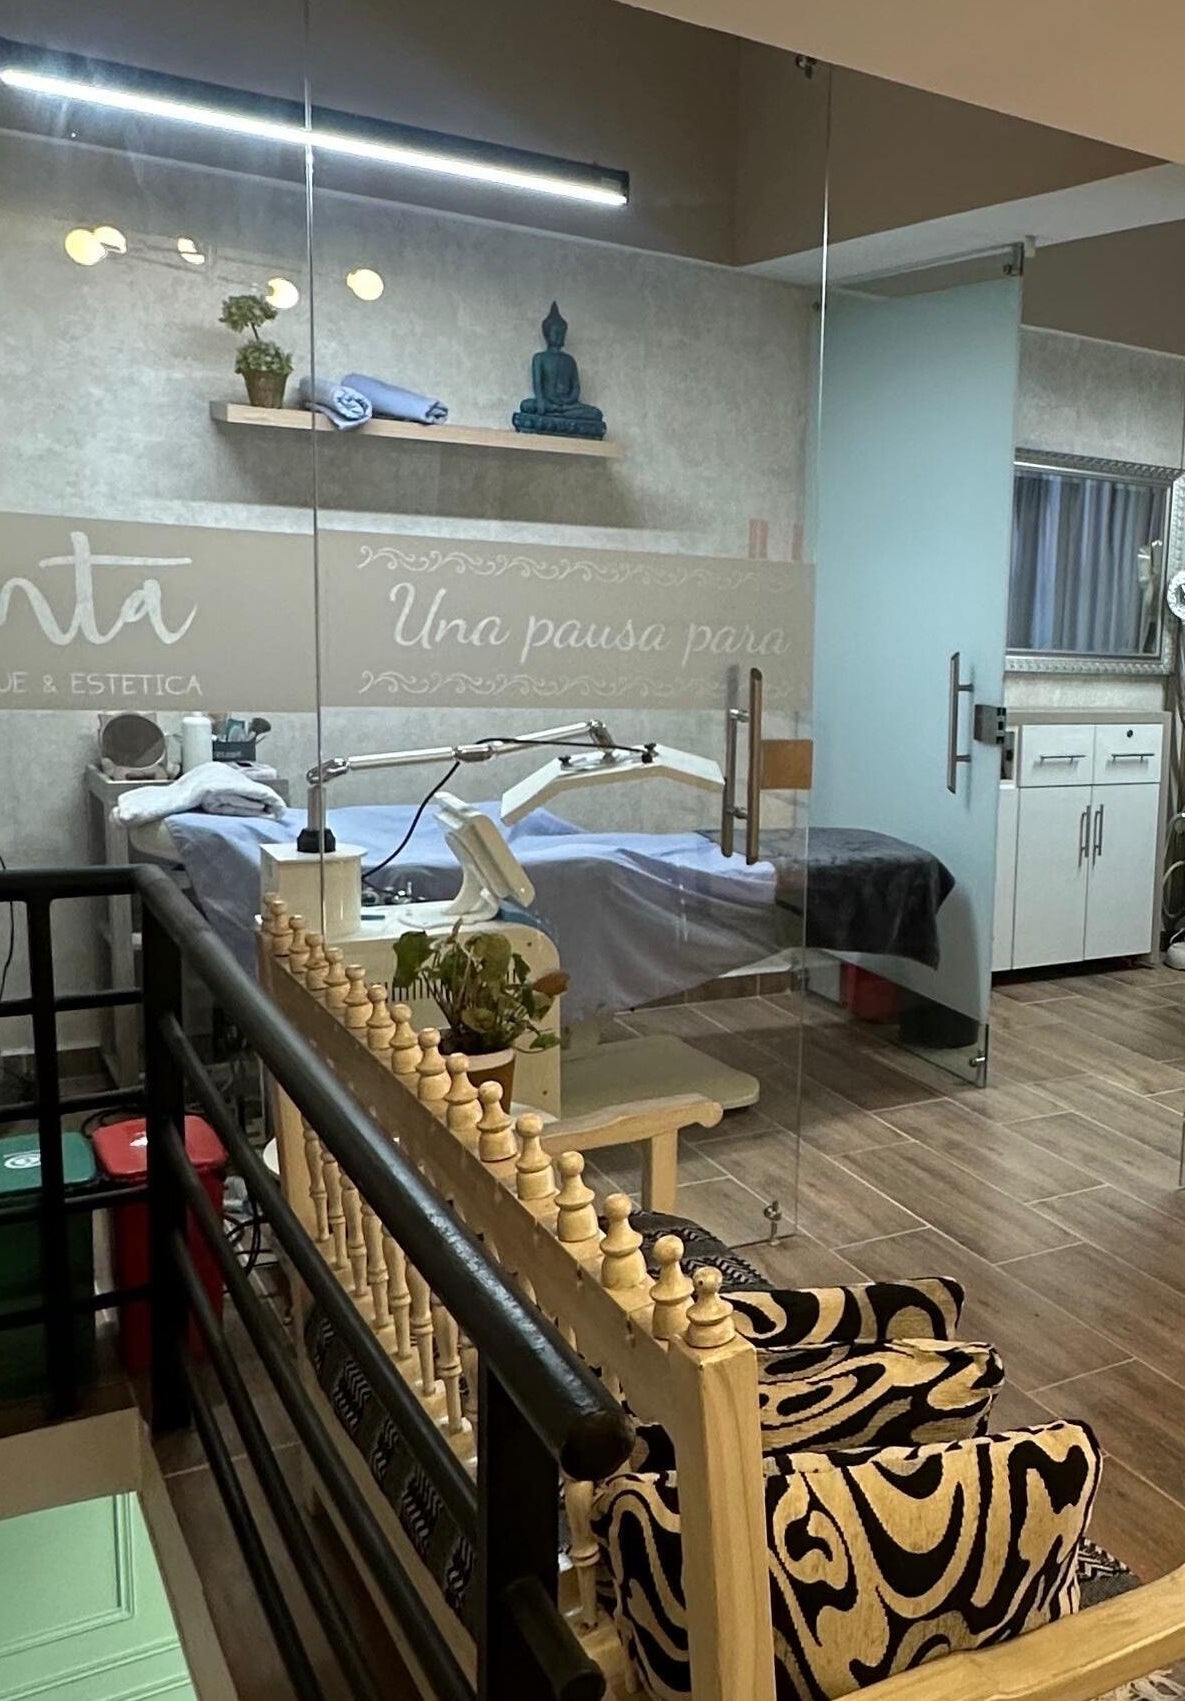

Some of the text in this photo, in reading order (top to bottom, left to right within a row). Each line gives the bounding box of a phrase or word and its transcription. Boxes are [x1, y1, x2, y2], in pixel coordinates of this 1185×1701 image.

[389, 582, 792, 669] Una pausa para
[43, 674, 58, 693] &
[70, 672, 204, 696] ESTETICA
